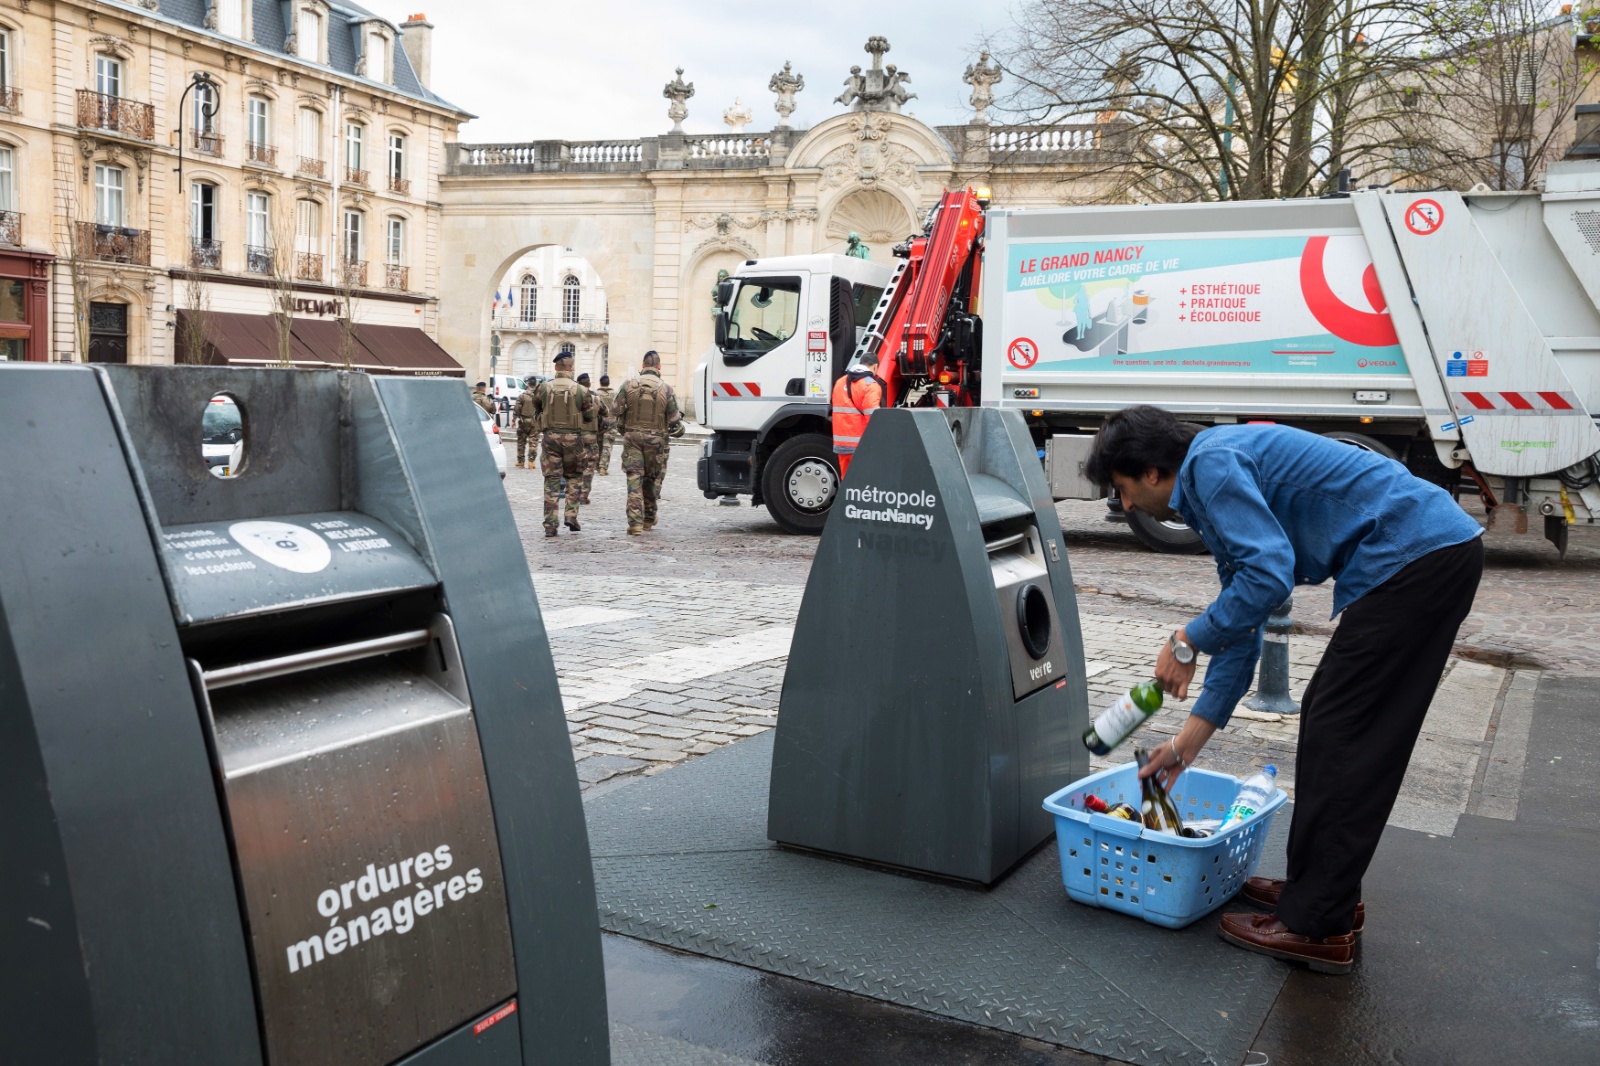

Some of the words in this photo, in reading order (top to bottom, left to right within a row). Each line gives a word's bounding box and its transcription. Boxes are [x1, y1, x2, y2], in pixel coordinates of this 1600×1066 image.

[1020, 259, 1037, 274] LE
[1040, 252, 1090, 271] GRAND
[1093, 245, 1144, 264] NANCY
[1020, 271, 1071, 288] AMÉLIORE
[1073, 267, 1105, 281] VOTRE
[1108, 262, 1143, 276] CADRE
[1145, 260, 1159, 272] DE
[1162, 258, 1179, 270] VIE
[1191, 282, 1261, 295] ESTHÉTIQUE
[1191, 298, 1246, 309] PRATIQUE
[1179, 314, 1186, 322] +
[1190, 309, 1261, 322] ÉCOLOGIQUE
[807, 352, 828, 362] 1133
[845, 485, 936, 508] métropole
[845, 504, 934, 530] GrandNancy
[324, 530, 348, 540] MES
[215, 548, 243, 559] pour
[184, 565, 208, 576] les
[206, 560, 257, 574] cochons
[1029, 661, 1052, 681] verre
[317, 844, 453, 917] ordures
[286, 867, 484, 974] ménagères
